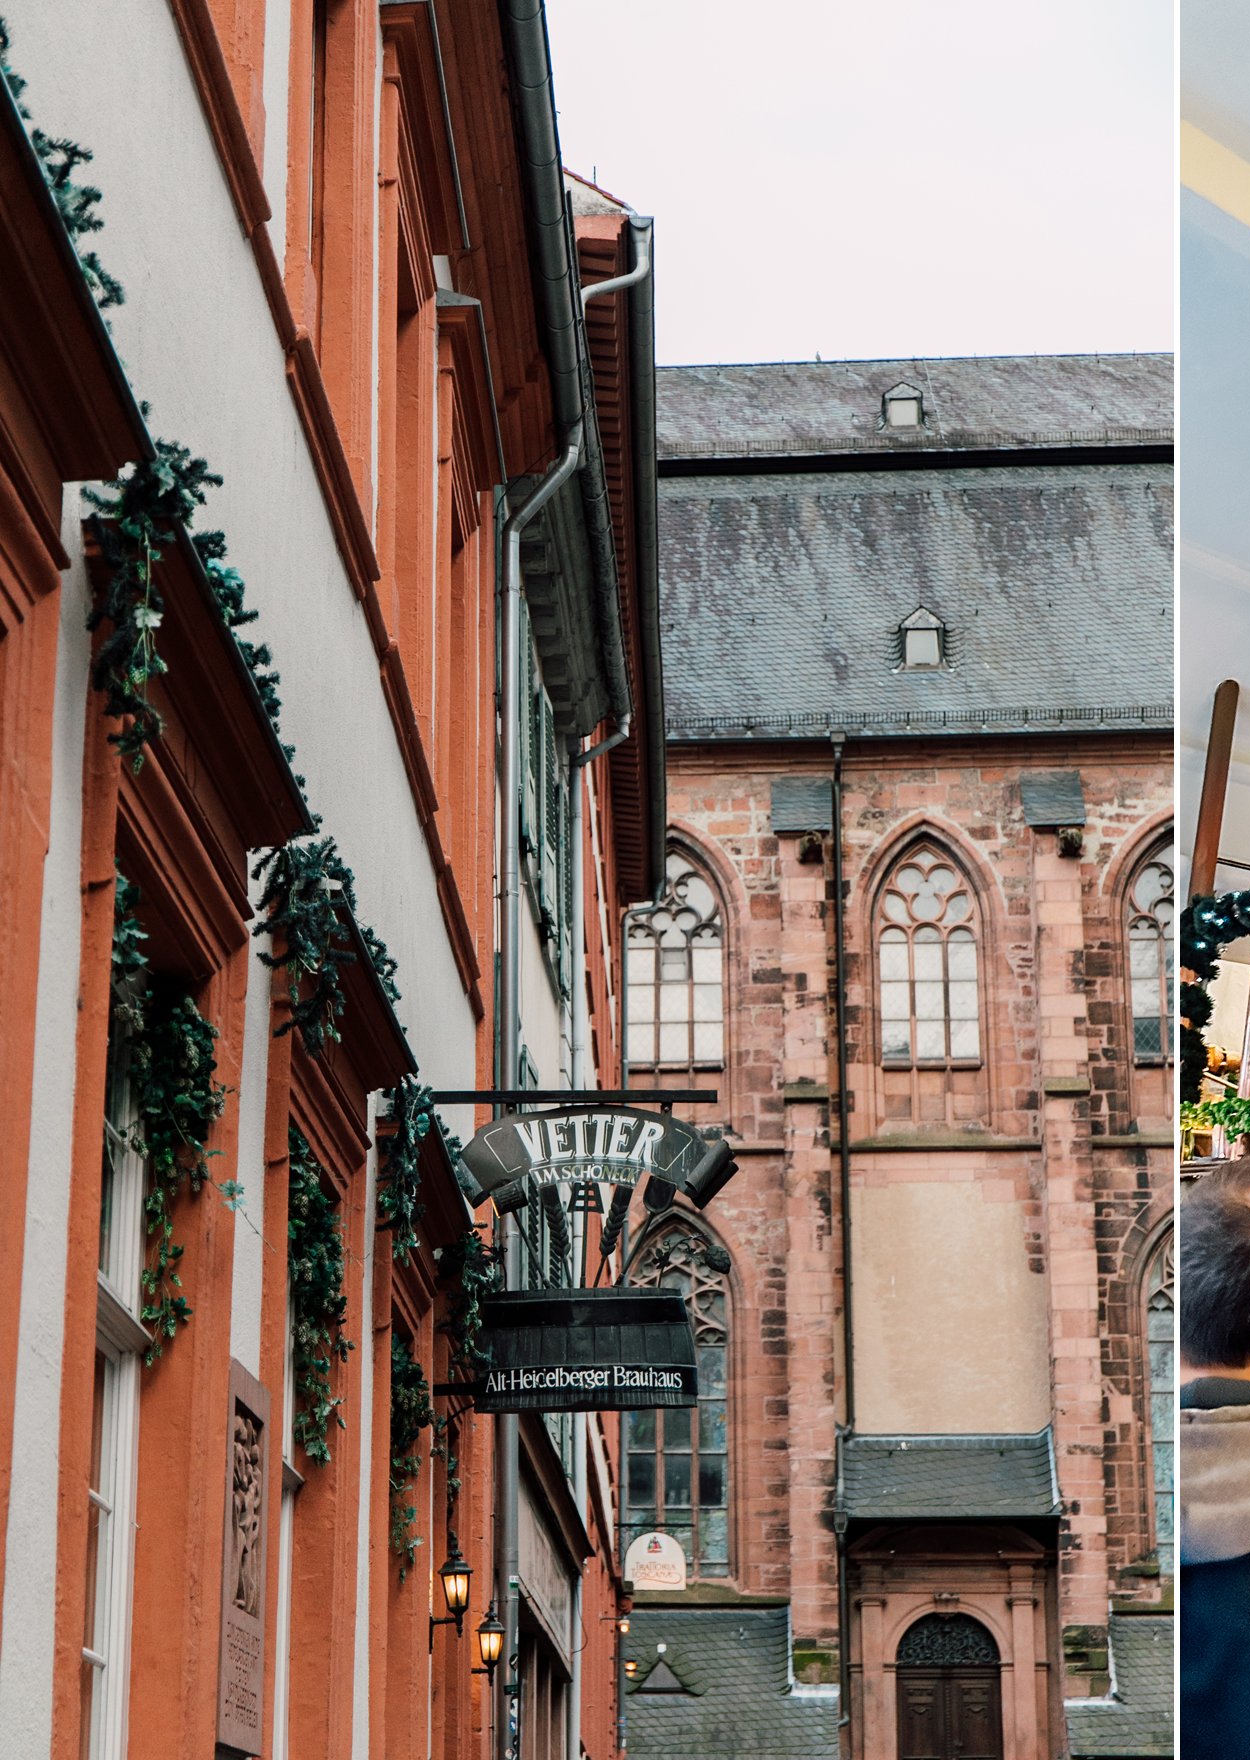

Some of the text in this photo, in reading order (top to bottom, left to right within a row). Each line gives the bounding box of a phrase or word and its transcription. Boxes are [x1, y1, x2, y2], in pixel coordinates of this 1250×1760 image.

[513, 1114, 665, 1167] VETTER
[534, 1163, 639, 1184] IM SCHÖNECK
[486, 1365, 683, 1393] Alt-Heidelberger Brauhaus
